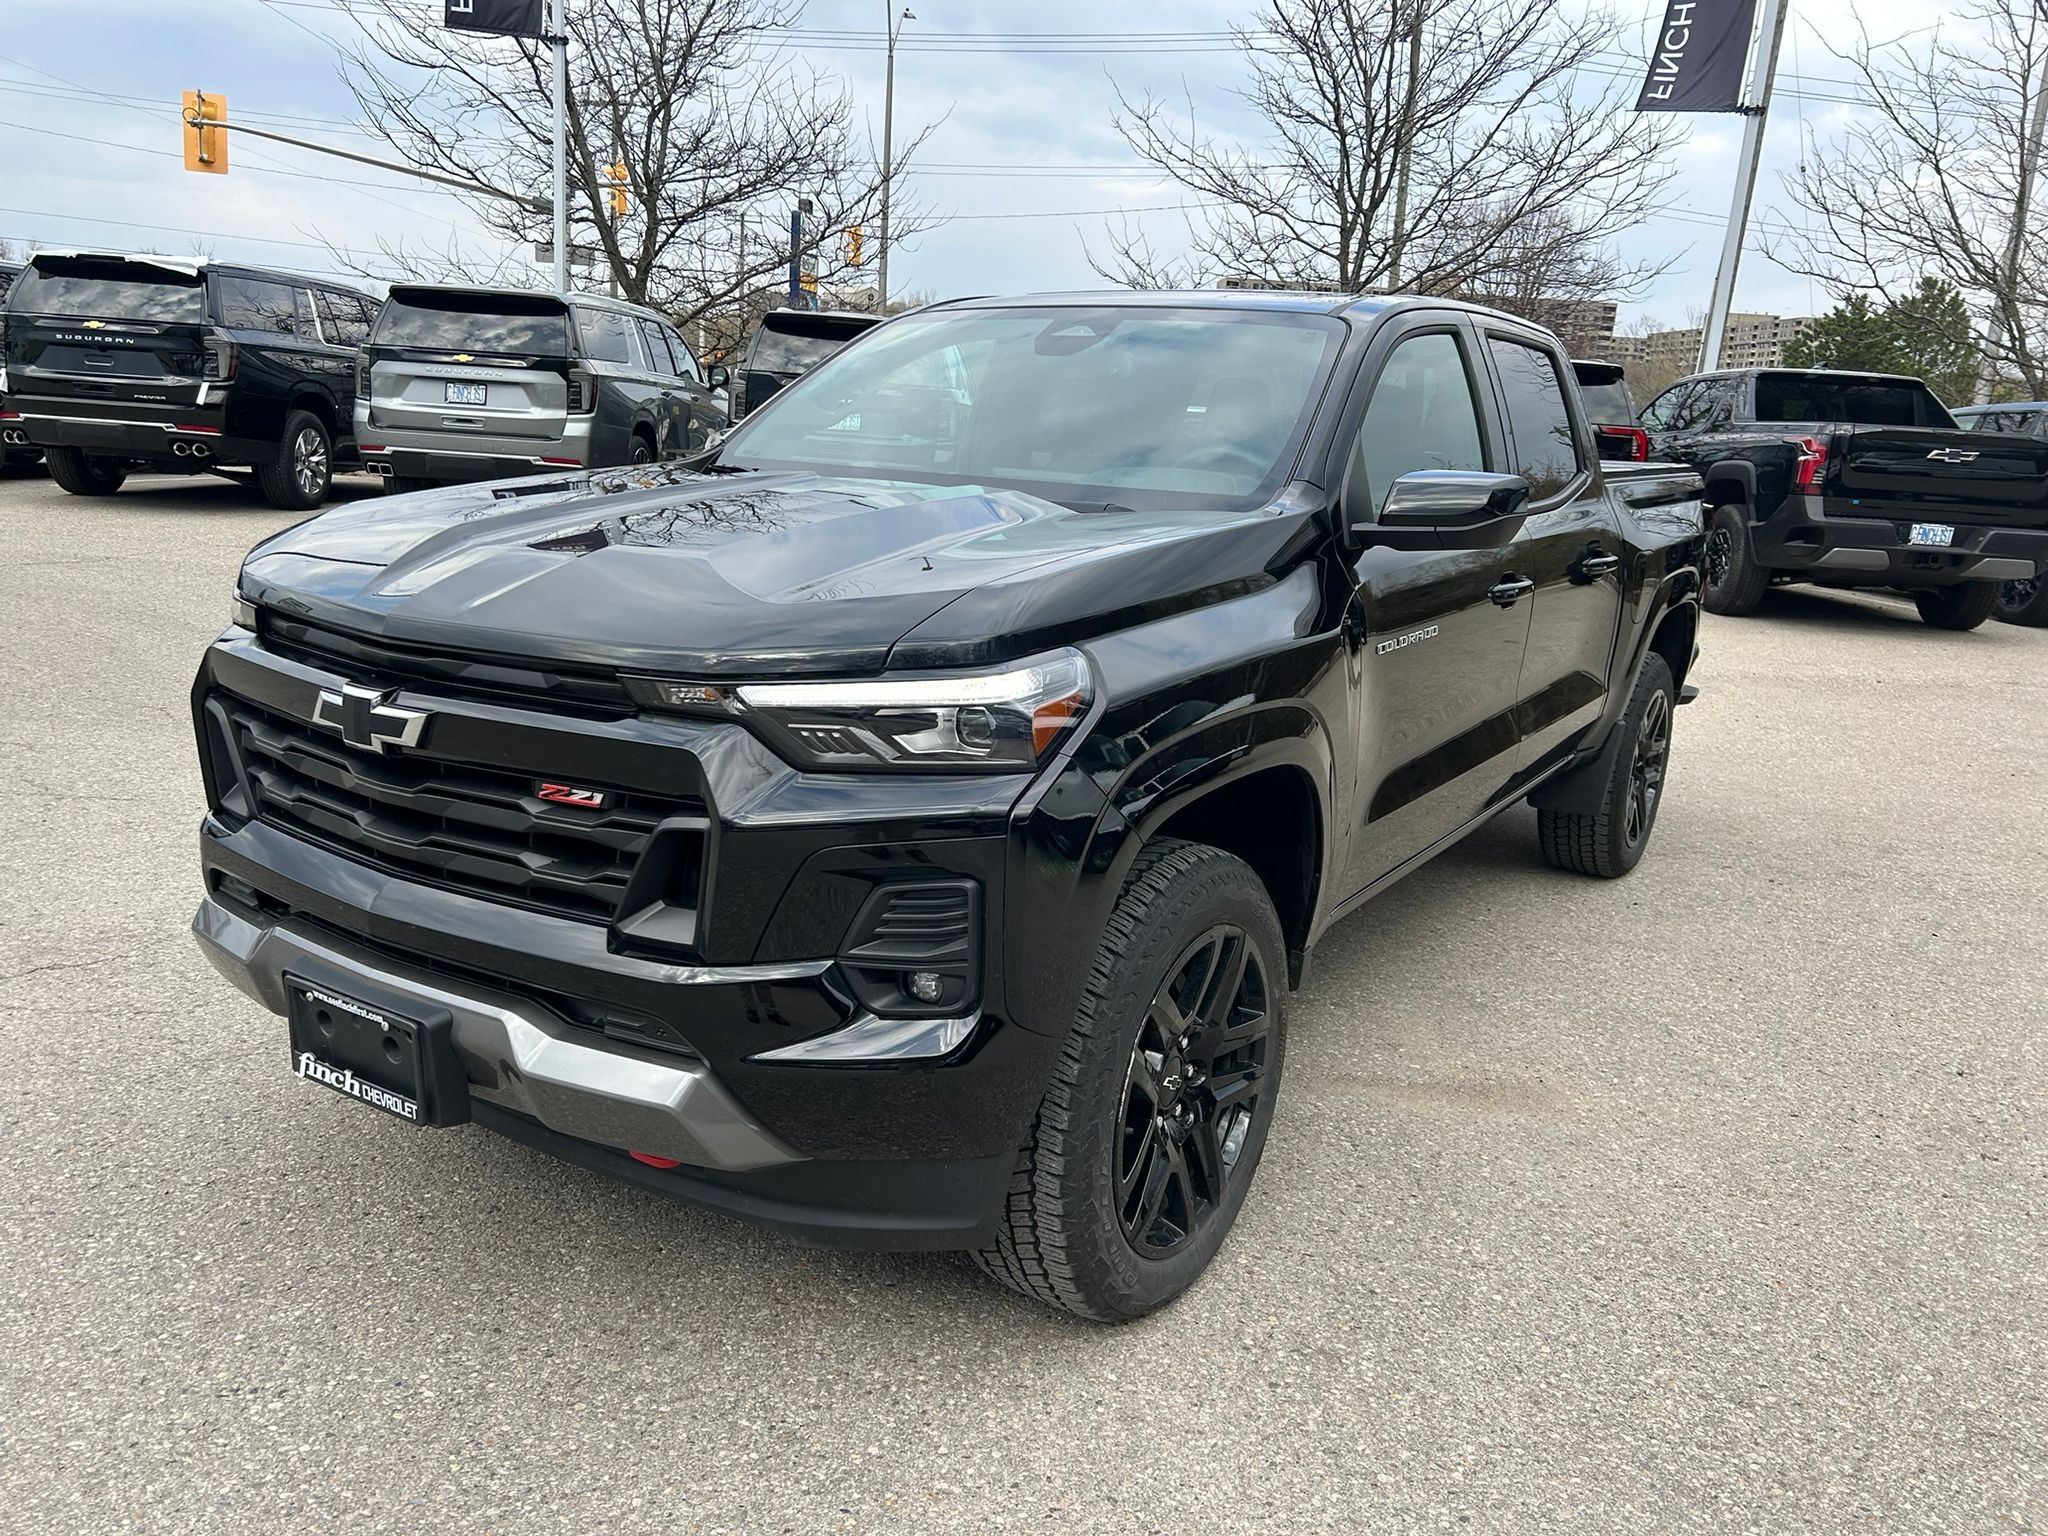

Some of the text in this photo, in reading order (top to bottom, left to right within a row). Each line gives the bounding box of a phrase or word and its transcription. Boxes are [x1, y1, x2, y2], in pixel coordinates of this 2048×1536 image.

[56, 334, 134, 344] SUBURBAN
[425, 366, 503, 377] SUBURBAN
[1377, 625, 1438, 654] COLORADO
[538, 783, 604, 808] Z71
[295, 1052, 417, 1119] finch CHEVROLET
